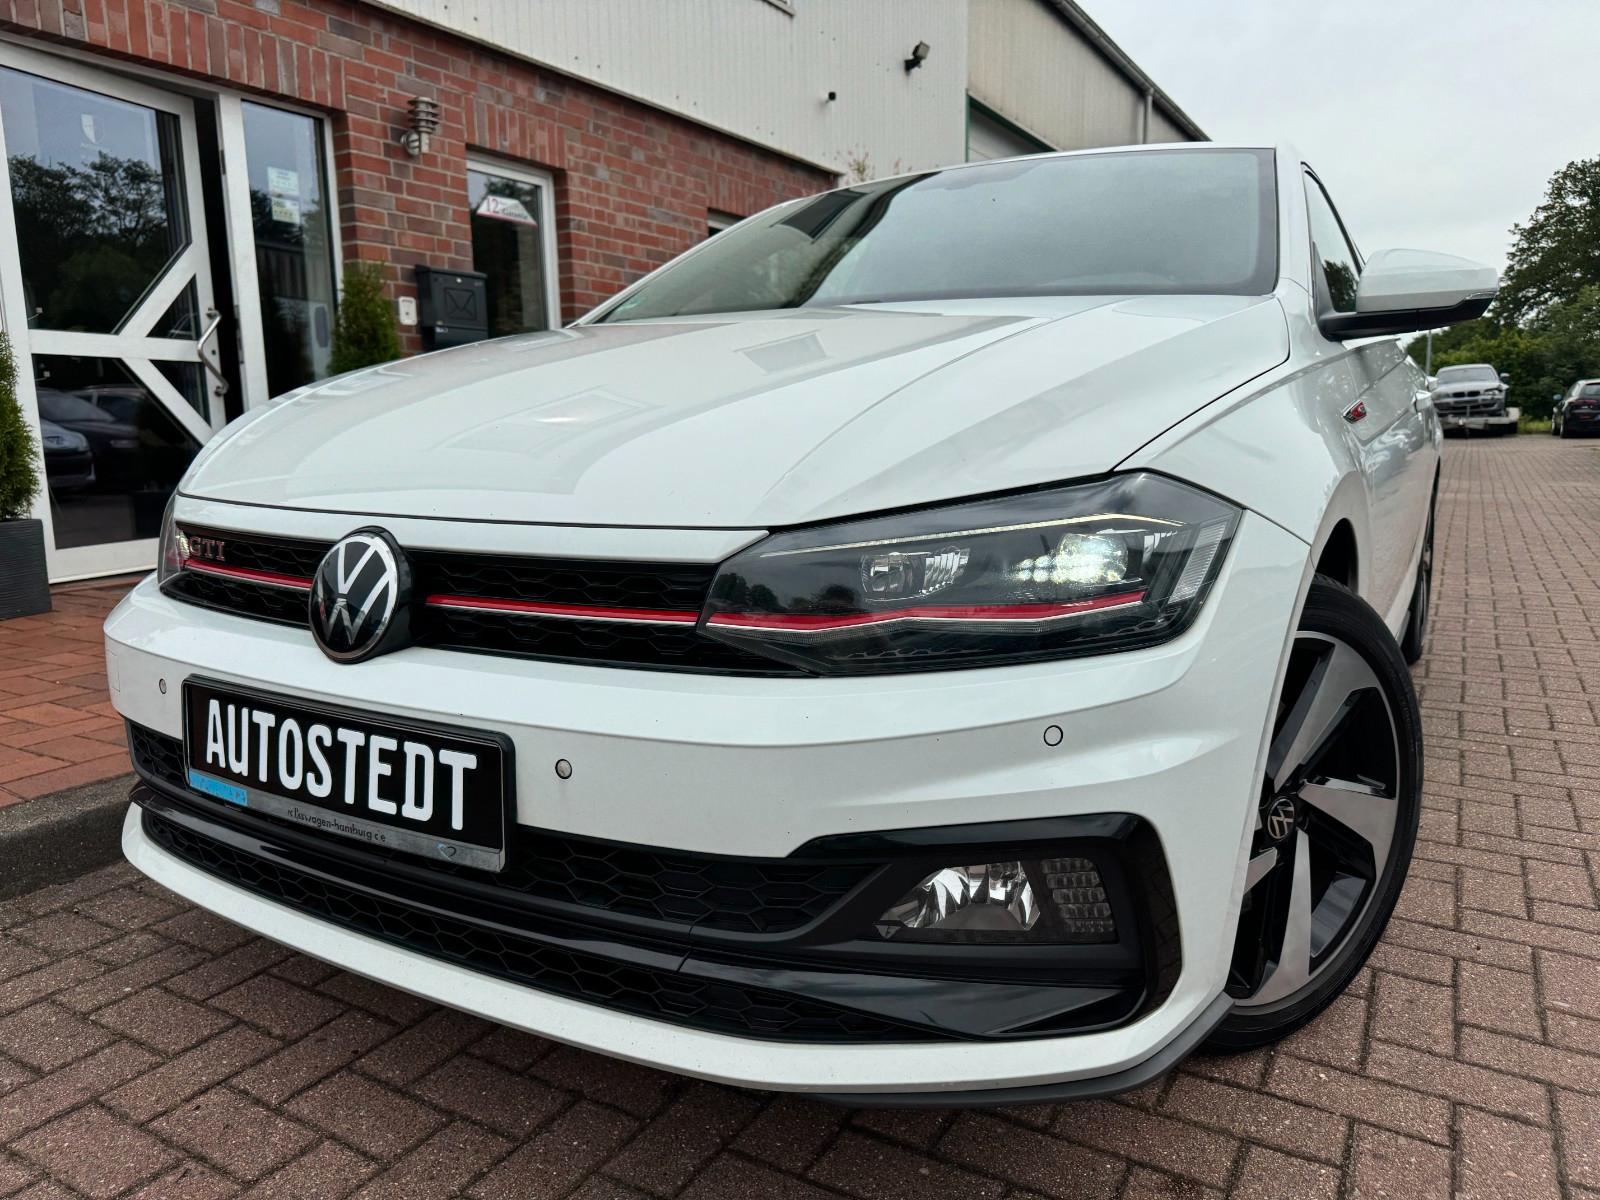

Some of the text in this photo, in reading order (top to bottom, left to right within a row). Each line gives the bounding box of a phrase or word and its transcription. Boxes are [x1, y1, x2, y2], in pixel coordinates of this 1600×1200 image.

[486, 198, 500, 214] 12
[189, 536, 225, 561] GTI
[314, 533, 397, 650] VW
[206, 699, 477, 831] AUTOSTEDT
